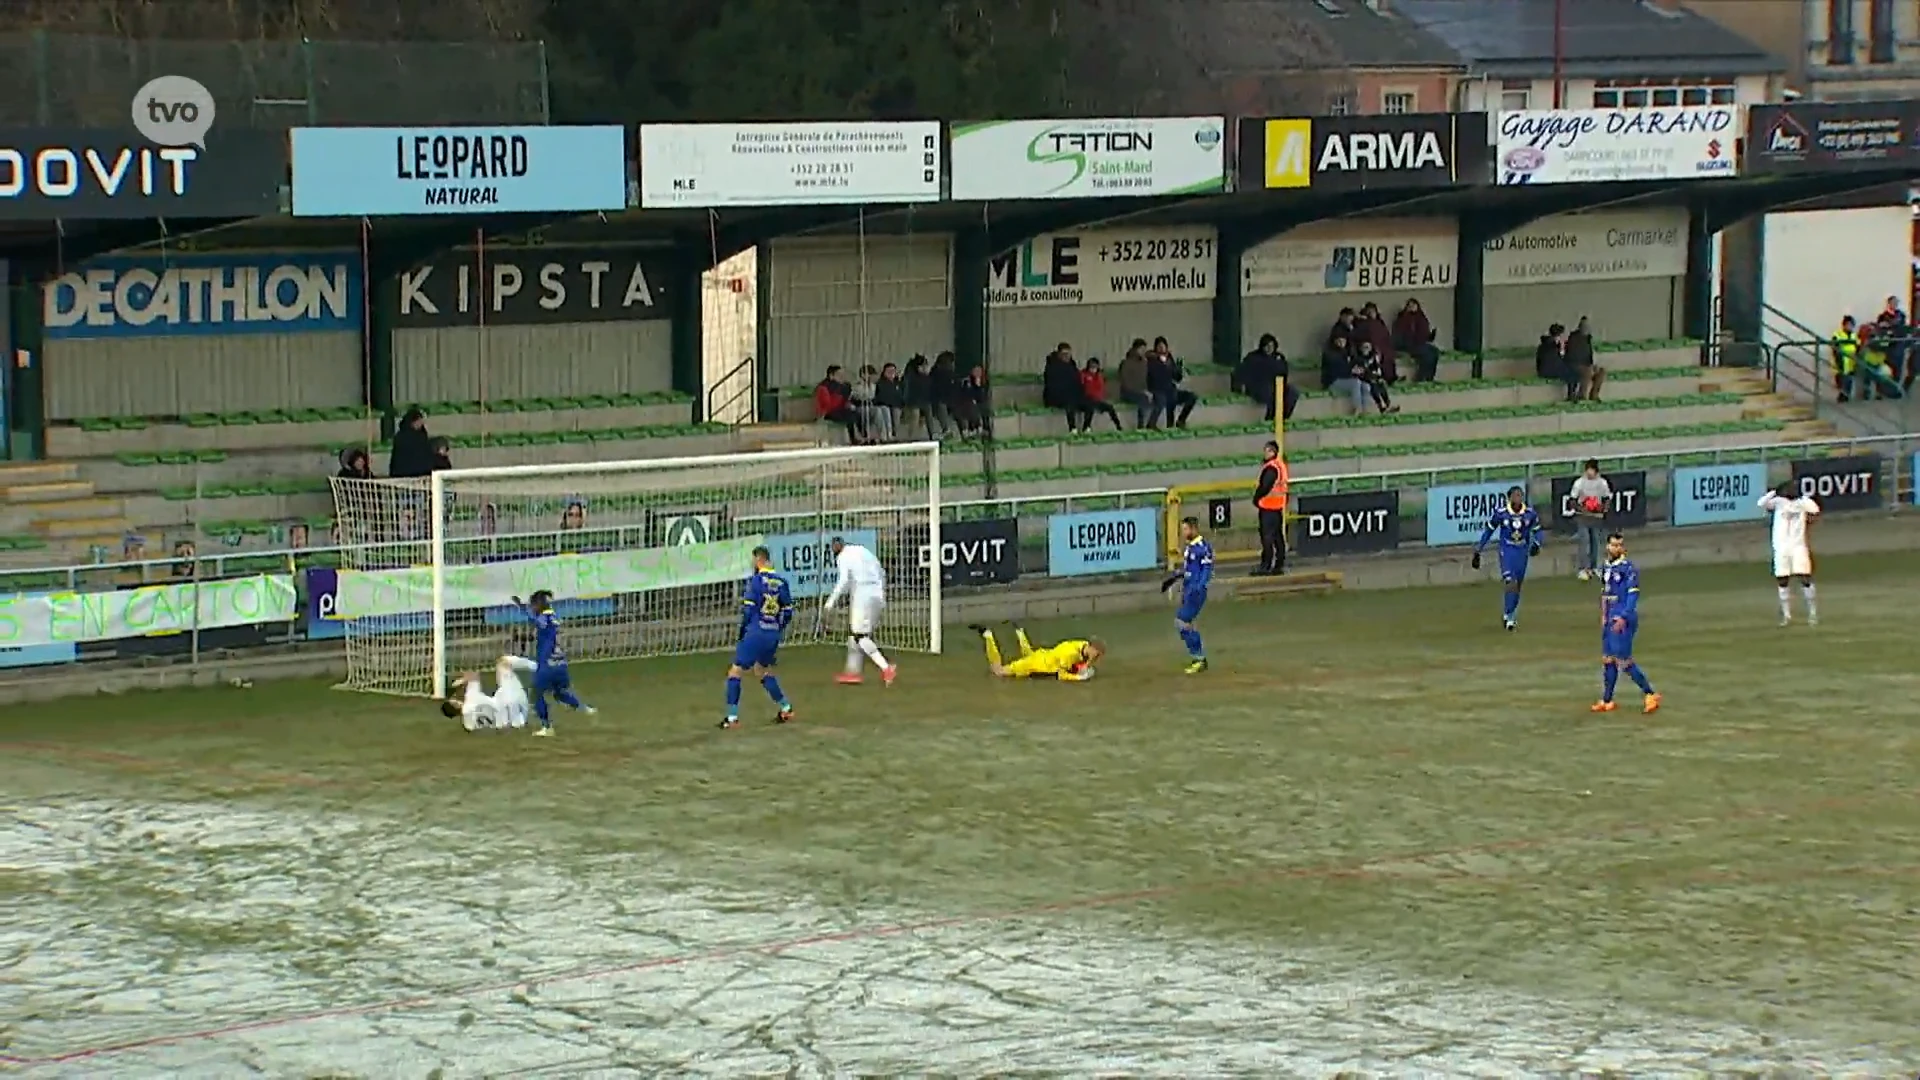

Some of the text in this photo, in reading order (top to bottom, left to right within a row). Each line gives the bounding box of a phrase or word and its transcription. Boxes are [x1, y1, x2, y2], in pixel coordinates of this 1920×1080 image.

[1502, 110, 1731, 150] Garage DARAND
[397, 134, 528, 179] LEOPARD
[1317, 132, 1445, 171] ARMA
[1092, 159, 1153, 175] Saint-Mard
[425, 186, 499, 205] NATURAL
[673, 178, 696, 190] MLE
[1146, 240, 1167, 260] 20
[1170, 239, 1191, 258] 28
[1194, 238, 1212, 258] 51
[1509, 232, 1578, 250] Automotive
[1606, 228, 1677, 248] Carmarket
[988, 236, 1080, 288] MLE
[1359, 244, 1420, 266] NOEL
[400, 261, 653, 315] KIPSTA
[1110, 267, 1206, 292] www.mle.lu
[1359, 264, 1450, 287] BUREAU
[44, 265, 347, 327] DECATHLON
[1020, 288, 1028, 301] &
[1030, 286, 1083, 302] consulting
[1692, 475, 1750, 500] LEOPARD
[1801, 472, 1872, 497] DOVIT
[1215, 505, 1226, 523] 8
[1309, 509, 1388, 536] DOVIT
[1069, 521, 1137, 549] LEOPARD
[1083, 550, 1121, 562] NATURAL
[51, 594, 105, 640] EN
